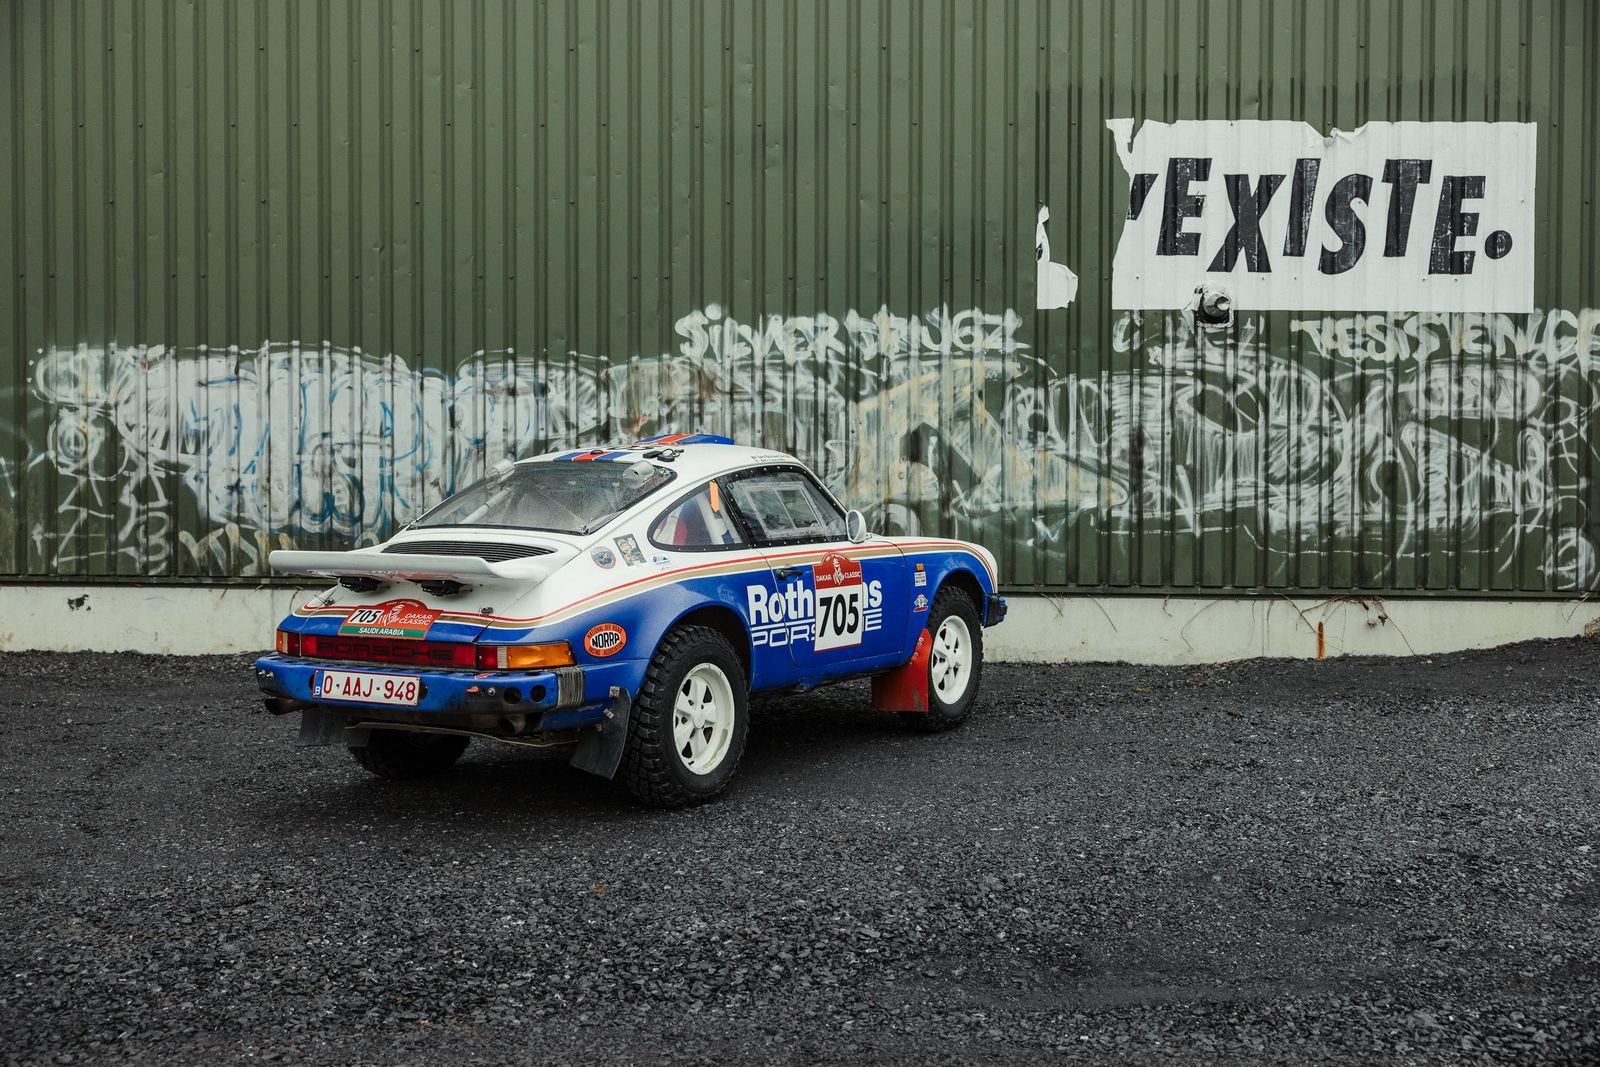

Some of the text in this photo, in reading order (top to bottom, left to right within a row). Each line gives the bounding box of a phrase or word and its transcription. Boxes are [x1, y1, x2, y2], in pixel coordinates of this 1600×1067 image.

[816, 571, 861, 582] DAKAR CLASSIC
[746, 580, 882, 625] Roths
[350, 609, 382, 623] 705
[819, 593, 859, 638] 705
[379, 628, 404, 636] ARABIA
[751, 613, 882, 647] PORE
[319, 642, 453, 661] PORSCHE
